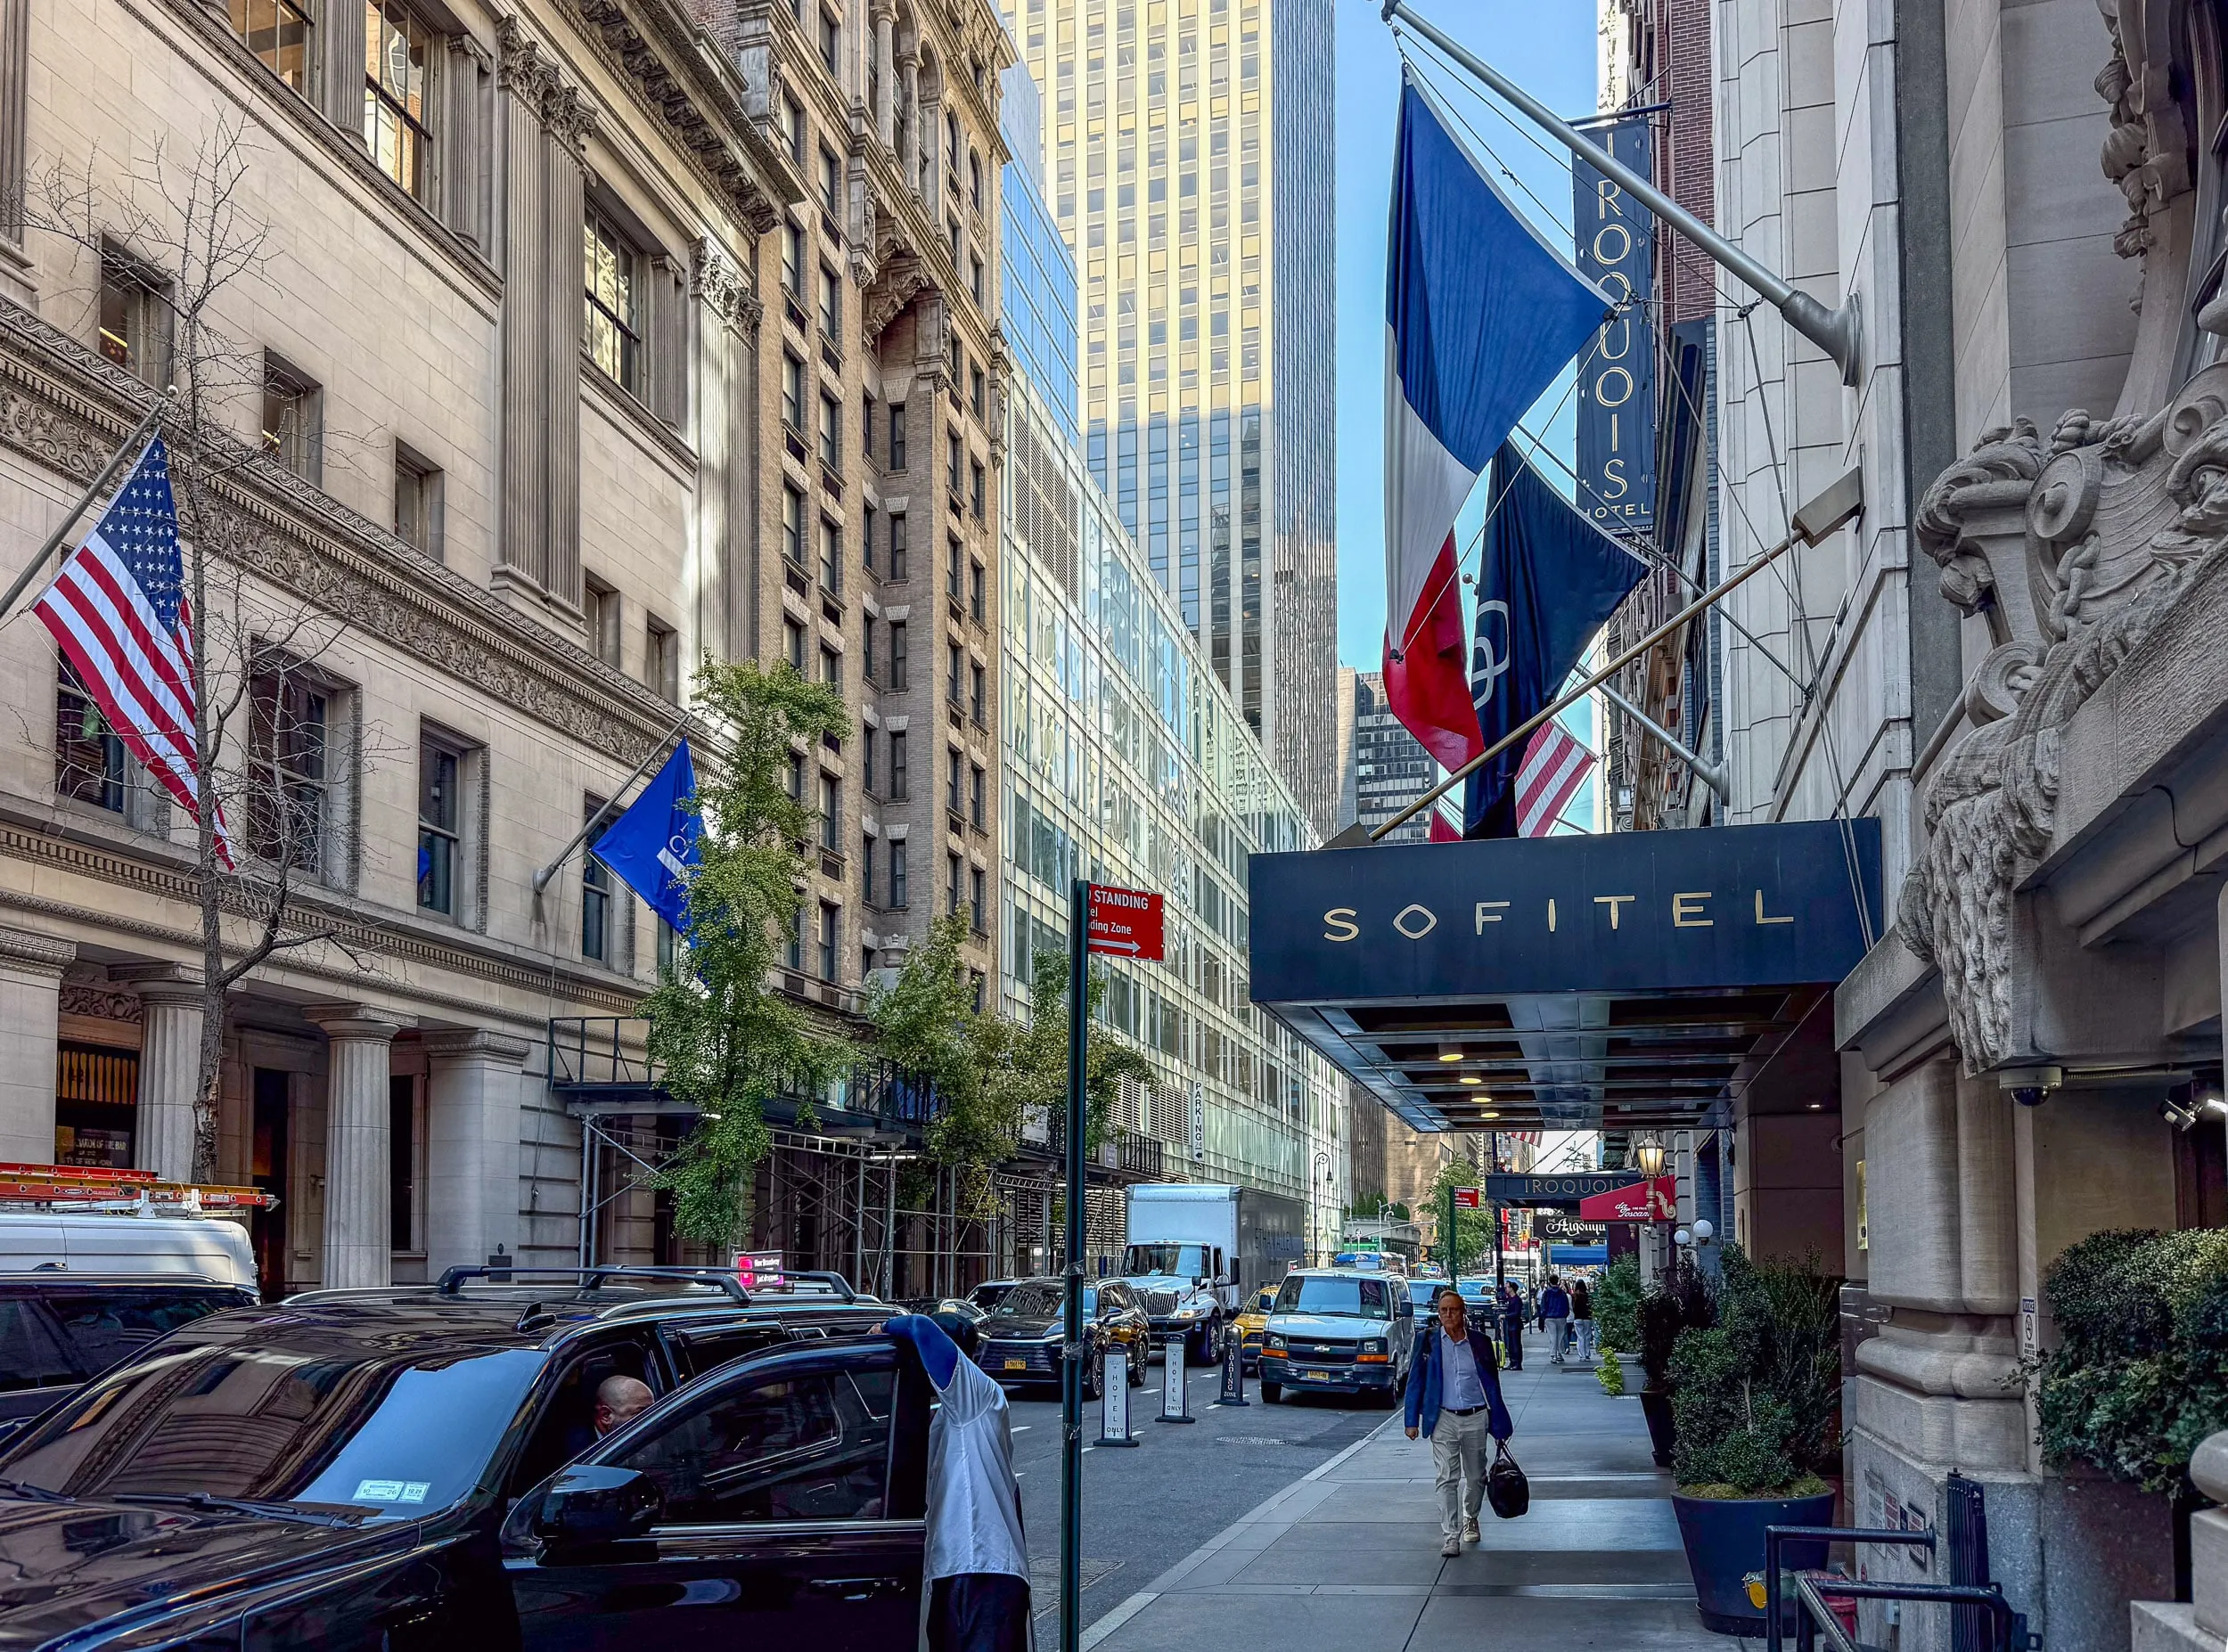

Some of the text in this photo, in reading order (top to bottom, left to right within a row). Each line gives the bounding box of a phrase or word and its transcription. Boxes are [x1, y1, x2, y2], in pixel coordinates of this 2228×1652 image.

[1593, 132, 1634, 499] IROQUOIS
[1088, 905, 1098, 917] el
[1094, 889, 1149, 910] STANDING
[1323, 889, 1795, 943] SOFITEL
[1088, 919, 1132, 935] ding Zone
[1194, 1082, 1202, 1141] PARKING
[1227, 1347, 1235, 1391] LOADING
